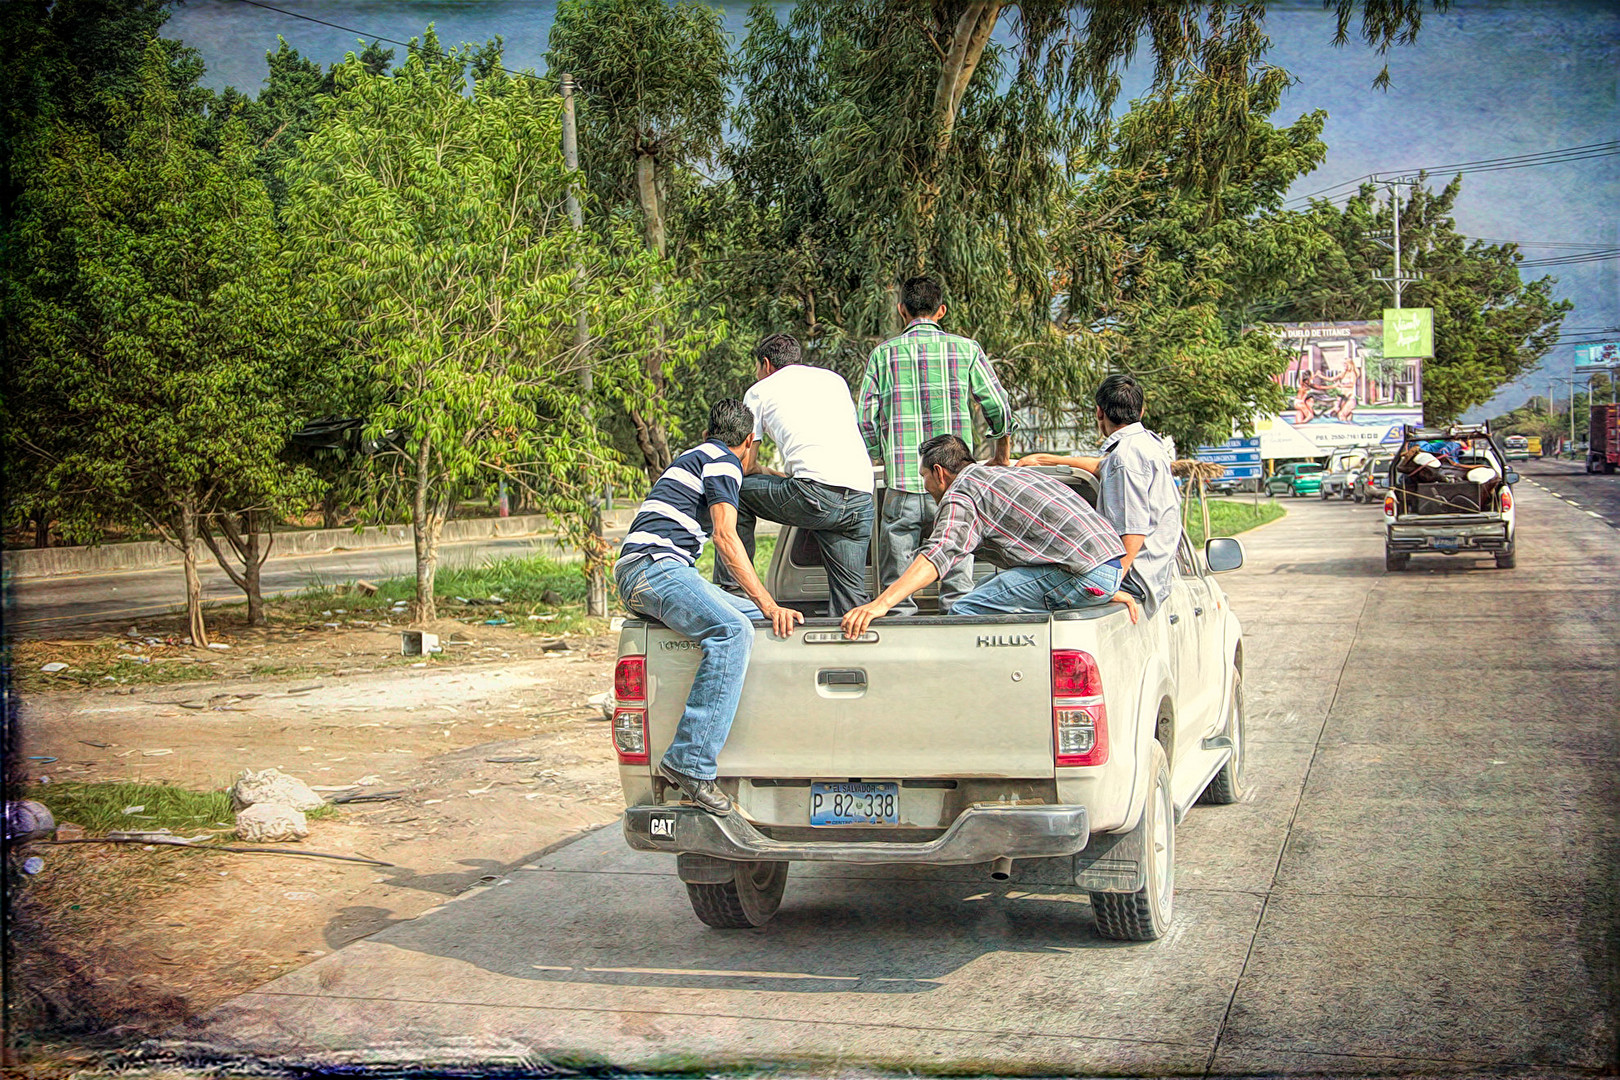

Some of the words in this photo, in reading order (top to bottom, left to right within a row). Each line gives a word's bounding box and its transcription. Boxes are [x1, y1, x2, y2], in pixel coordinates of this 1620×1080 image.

[1288, 328, 1310, 338] DUELO
[1311, 328, 1321, 337] DE
[1321, 328, 1351, 337] TITANES
[976, 634, 1036, 648] HILUX
[832, 784, 841, 793] EL
[842, 784, 876, 793] SALVADOR
[813, 793, 823, 817] P
[833, 793, 854, 818] 82
[864, 793, 894, 818] 338
[650, 818, 675, 836] CAT
